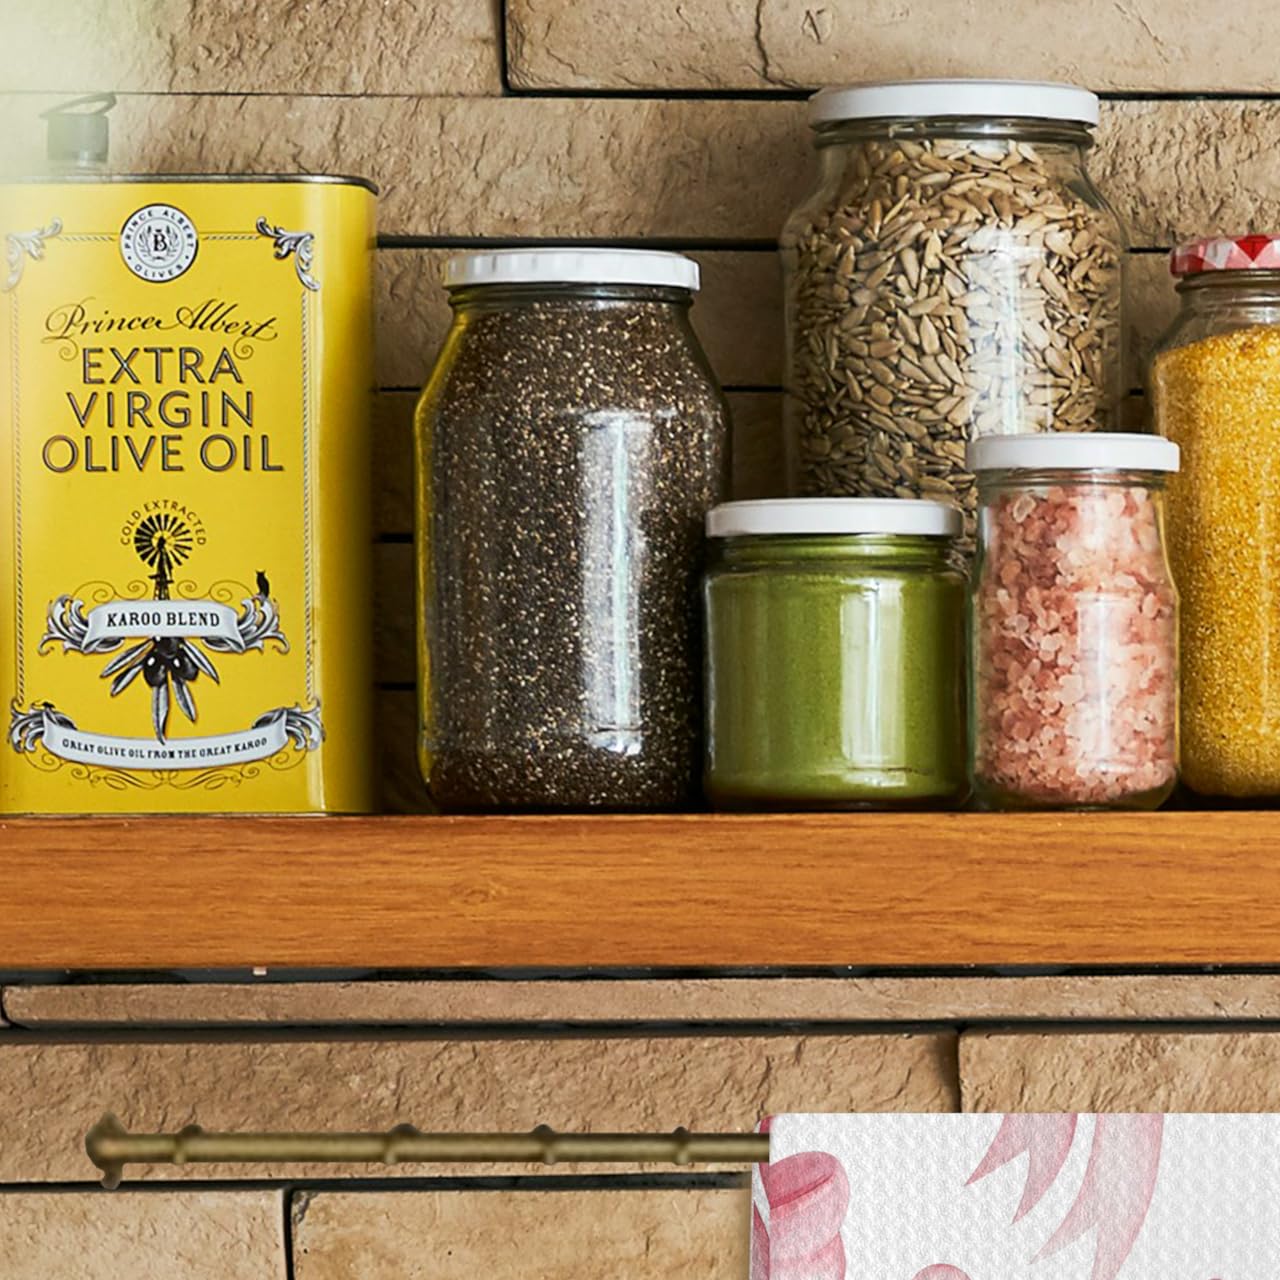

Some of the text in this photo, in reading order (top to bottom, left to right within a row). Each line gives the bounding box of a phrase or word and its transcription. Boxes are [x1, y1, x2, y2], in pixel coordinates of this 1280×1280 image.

[125, 210, 194, 249] PRINCE ALBERT
[134, 264, 183, 278] OLIVES
[42, 298, 278, 352] Prince Albert
[82, 347, 243, 385] EXTRA
[67, 390, 254, 429] VIRGIN
[42, 433, 285, 473] OLIVE OIL
[120, 499, 207, 546] COLD EXTRACTED
[107, 611, 220, 627] KAROO BLEND
[62, 737, 268, 759] GREAT OLIVE OIL FROM THE GREAT KAROO
